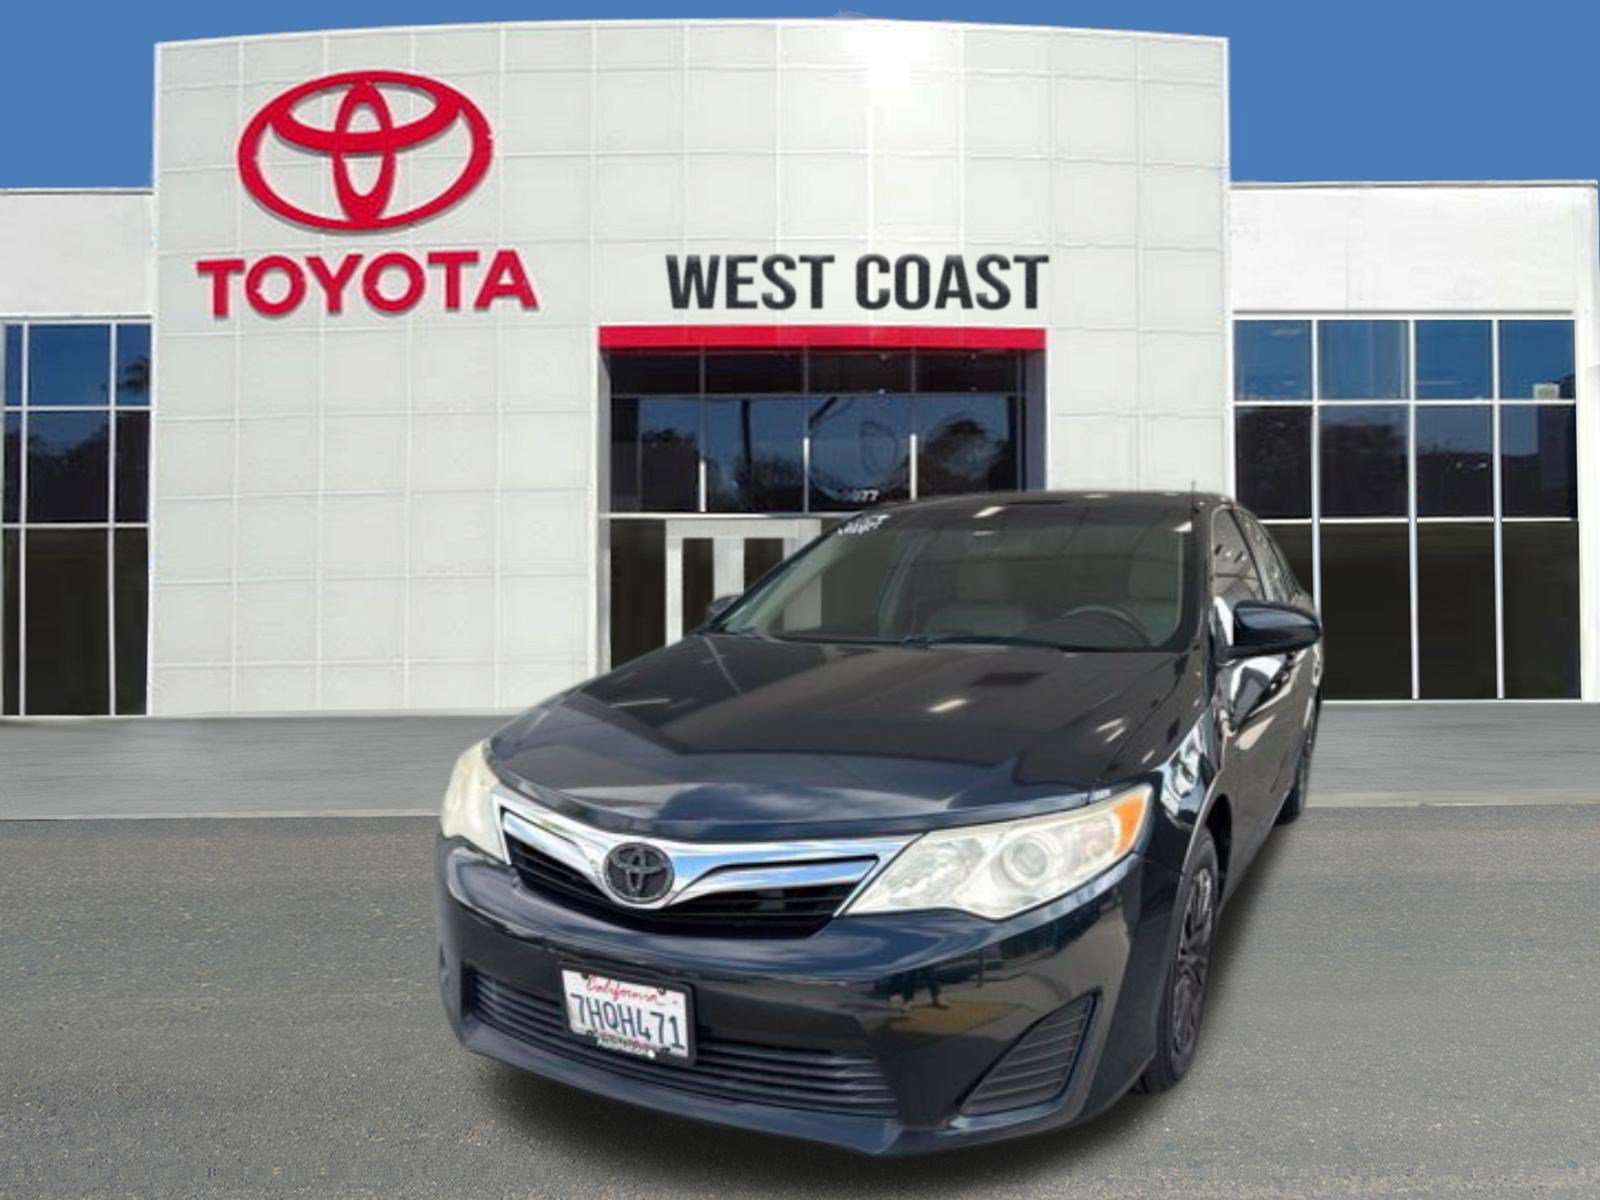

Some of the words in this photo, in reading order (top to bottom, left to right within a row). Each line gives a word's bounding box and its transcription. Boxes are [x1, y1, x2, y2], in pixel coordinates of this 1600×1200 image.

[197, 250, 538, 316] TOYOTA
[666, 254, 834, 309] WEST
[855, 254, 1050, 310] COAST
[586, 973, 658, 1003] California
